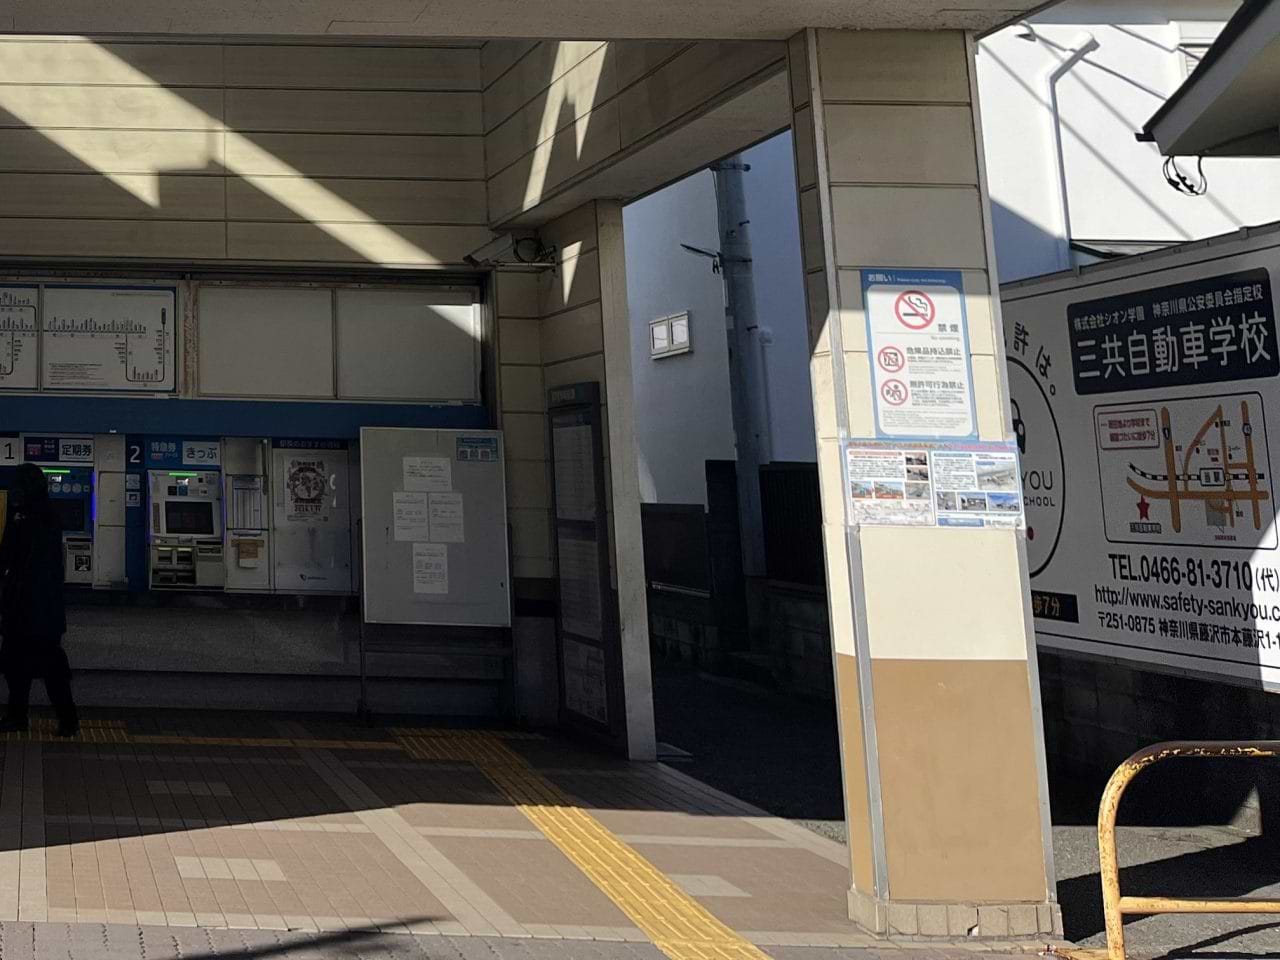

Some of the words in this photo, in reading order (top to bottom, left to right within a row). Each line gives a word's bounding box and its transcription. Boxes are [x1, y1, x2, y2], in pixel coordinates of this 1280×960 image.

[1074, 306, 1145, 331] 株式会社シオン学園
[1152, 284, 1264, 318] 神奈川県公安委員会指定校
[1077, 310, 1271, 379] 三共自動車学校
[5, 443, 15, 460] 1
[62, 444, 92, 457] 定期券
[130, 445, 141, 463] 2
[1108, 553, 1253, 591] TEL.0466-81-3710
